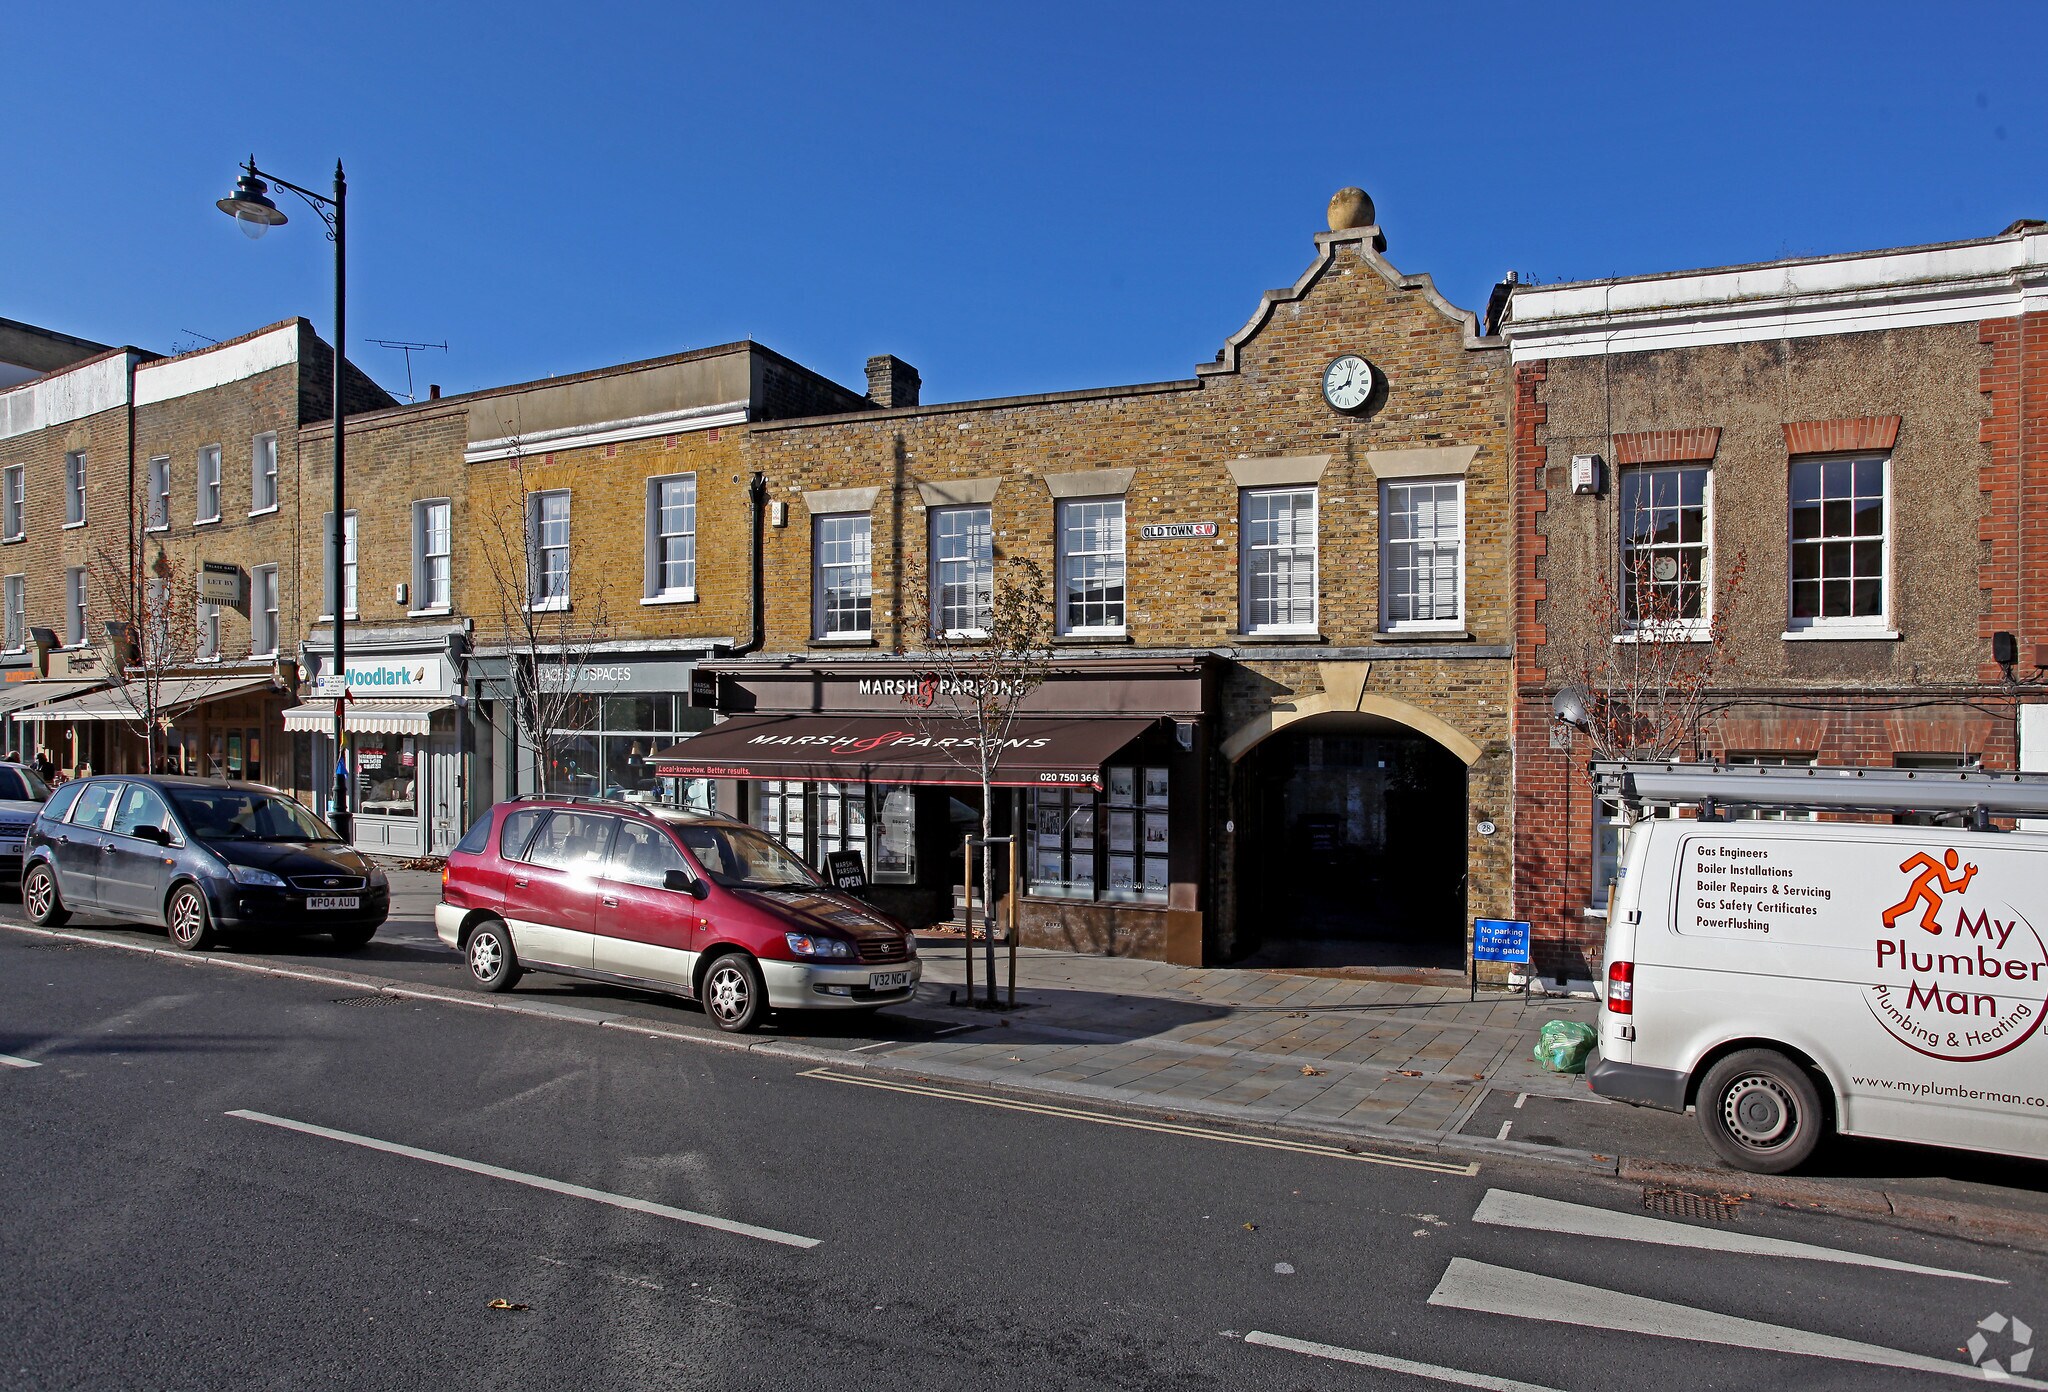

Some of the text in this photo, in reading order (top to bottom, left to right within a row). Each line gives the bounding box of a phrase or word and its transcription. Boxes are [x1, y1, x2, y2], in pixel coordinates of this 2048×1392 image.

[1143, 527, 1164, 537] OLD
[1164, 525, 1193, 536] TOWN
[345, 667, 411, 686] Woodlark
[859, 679, 918, 696] MARSH
[747, 735, 859, 746] MARSH
[888, 737, 1052, 749] PARSONS
[707, 766, 726, 774] Better
[727, 767, 751, 775] results.
[1040, 773, 1057, 782] 020
[1059, 773, 1079, 782] 7501
[1481, 824, 1492, 832] 28
[1697, 845, 1768, 860] Gas Engineers
[836, 866, 860, 875] PARSONS
[1697, 863, 1793, 878] Boiler Installations
[839, 875, 863, 889] OPEN
[1697, 880, 1831, 900] Boiler Repairs & Servicing
[311, 897, 356, 908] WP04 AUU
[1697, 898, 1817, 915] Gas Safety Certificates
[1480, 926, 1523, 937] No parking
[1696, 915, 1770, 934] PowerFlushing
[1954, 906, 2016, 950] My
[1491, 936, 1510, 945] front
[1513, 937, 1522, 945] of
[1478, 945, 1525, 956] these gates
[1876, 939, 2046, 982] Plumber
[874, 972, 907, 986] V32 NGW
[1905, 978, 1997, 1018] Man
[1871, 984, 2032, 1047] Plumbing & Heating
